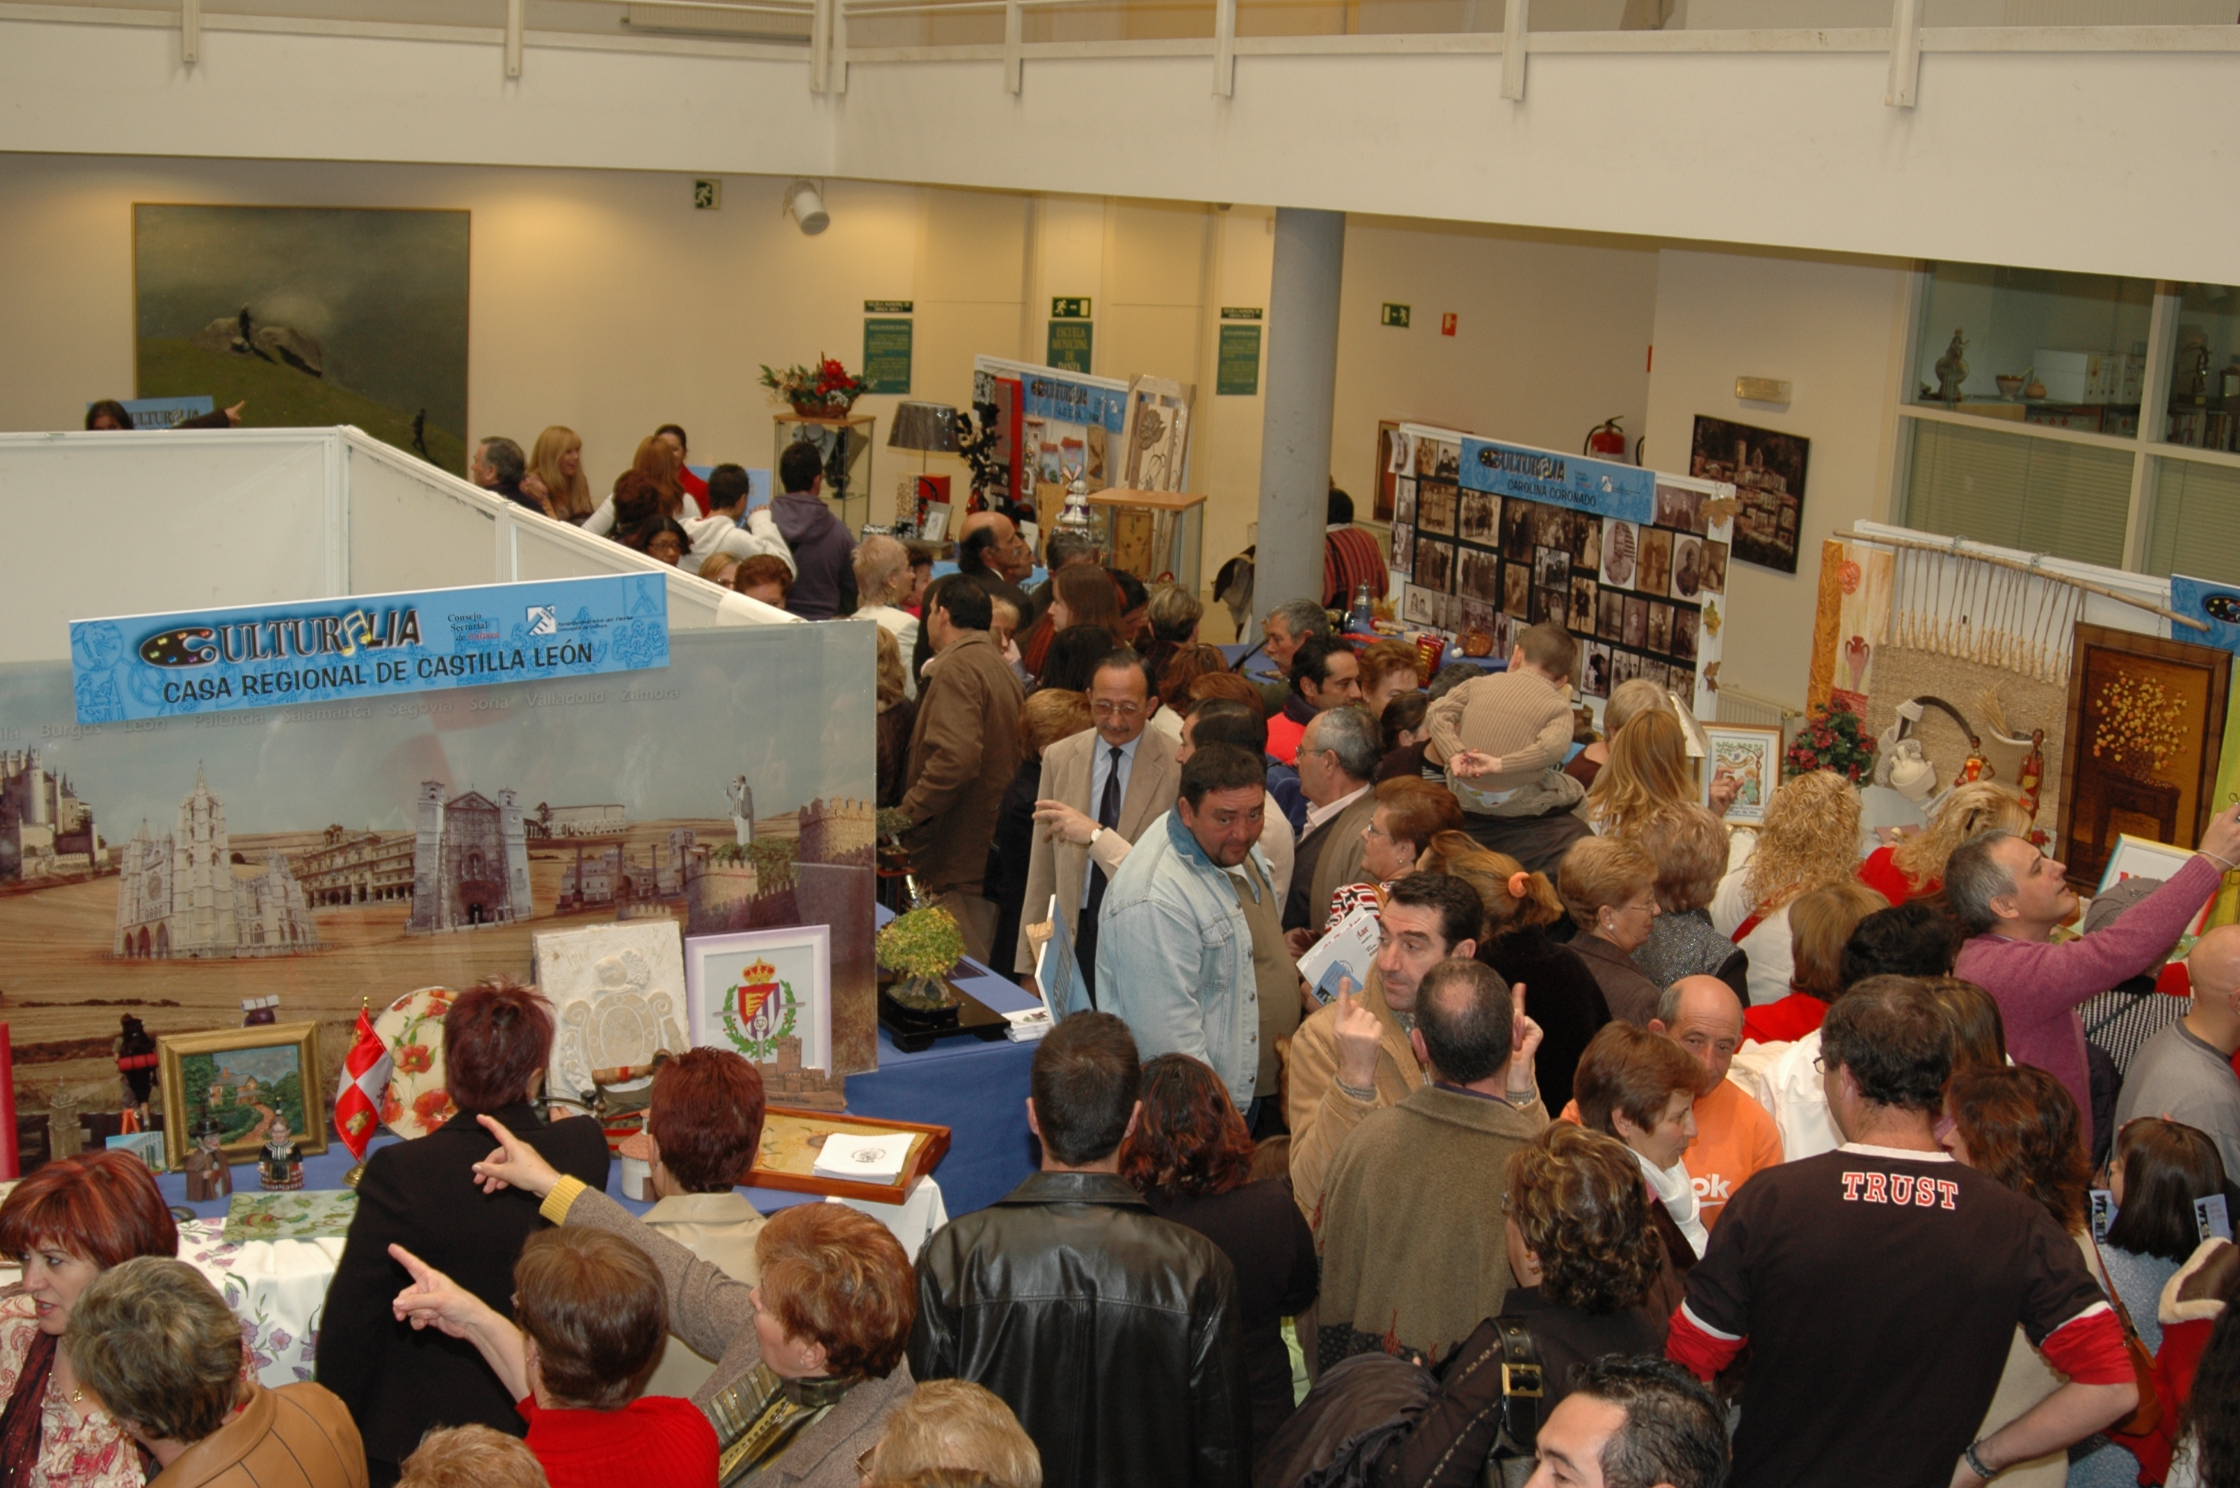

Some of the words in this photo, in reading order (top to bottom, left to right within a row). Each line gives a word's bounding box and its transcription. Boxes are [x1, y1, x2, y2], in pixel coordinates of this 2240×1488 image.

[1507, 479, 1548, 498] CAROLINA
[1549, 487, 1597, 508] CORONADO
[163, 677, 232, 704] CASA
[242, 664, 367, 697] REGIONAL
[376, 660, 407, 684] DE
[417, 648, 525, 679] CASTILLA
[535, 639, 593, 668] LEÓN
[526, 689, 607, 709] Valladolid
[1842, 1172, 1959, 1210] TRUST
